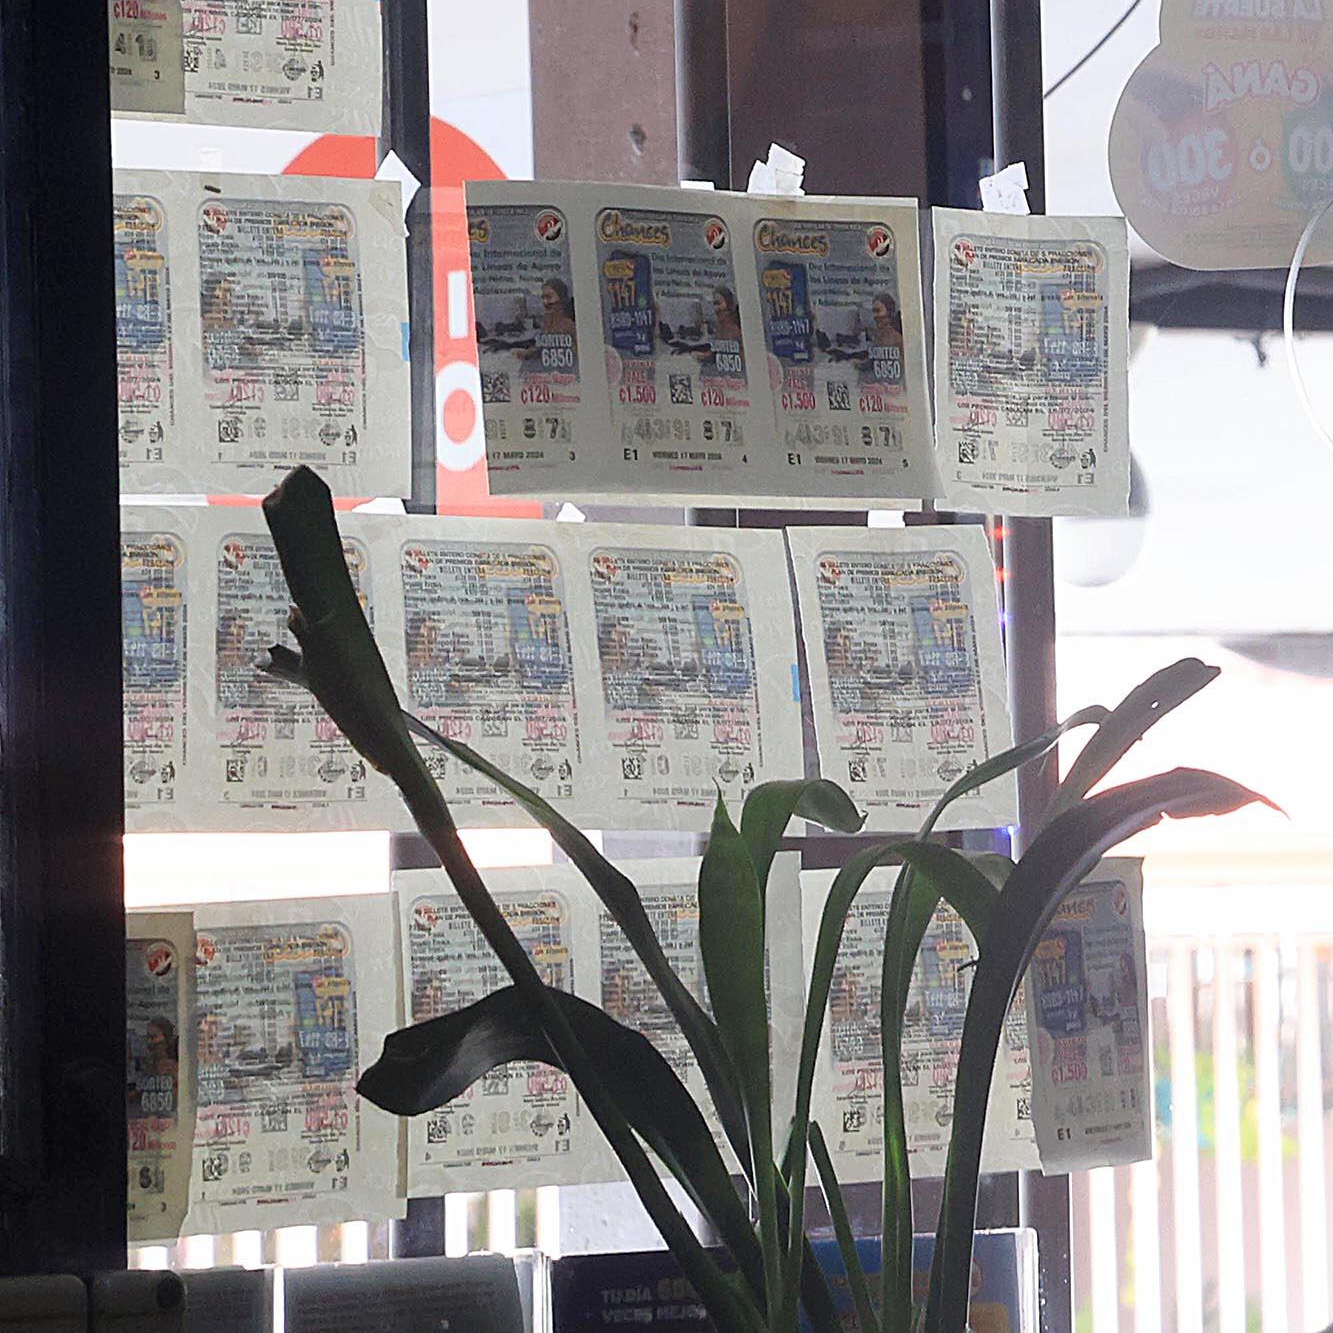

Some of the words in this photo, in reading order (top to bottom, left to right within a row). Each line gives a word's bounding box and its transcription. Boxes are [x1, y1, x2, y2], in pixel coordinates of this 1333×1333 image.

[600, 211, 672, 248] Chances
[757, 224, 830, 259] Chances
[541, 347, 573, 368] 6850
[715, 353, 743, 373] 6850
[873, 359, 901, 379] 6850
[623, 449, 639, 463] E1
[787, 453, 802, 466] E1
[141, 1092, 174, 1114] 6850
[1057, 1126, 1072, 1140] E1
